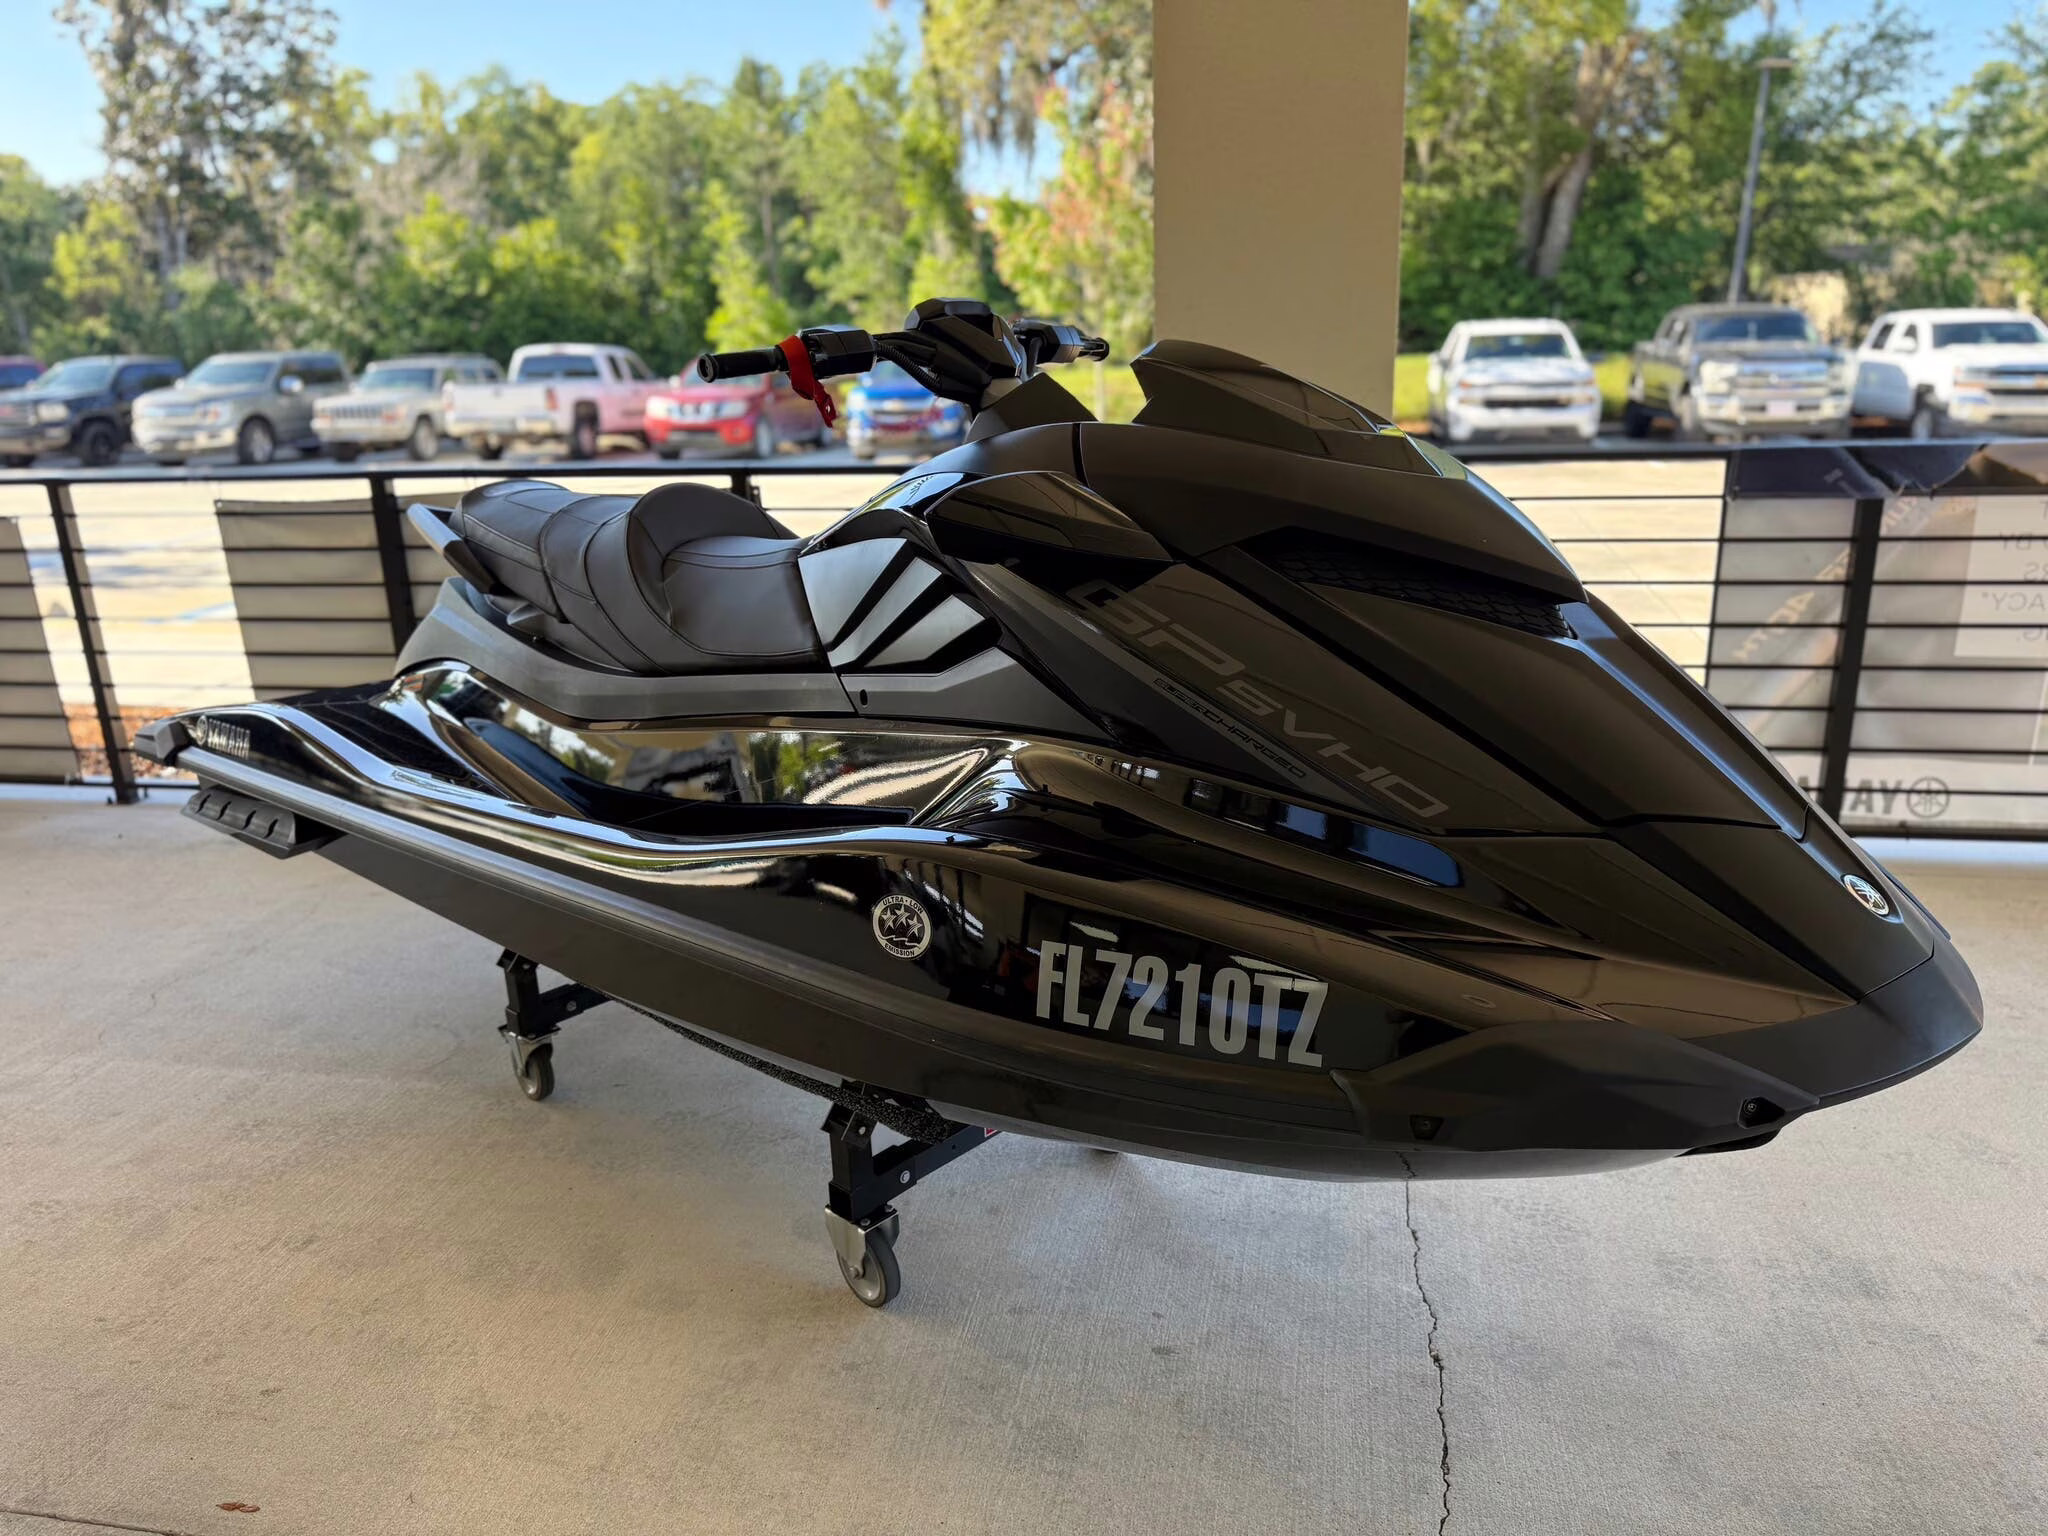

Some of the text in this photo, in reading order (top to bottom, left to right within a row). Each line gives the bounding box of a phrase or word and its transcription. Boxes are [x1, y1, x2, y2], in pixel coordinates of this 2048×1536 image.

[882, 896, 924, 914] ULTRA LOW
[884, 943, 915, 957] EMISSION
[1036, 940, 1329, 1068] FL7210TZ
